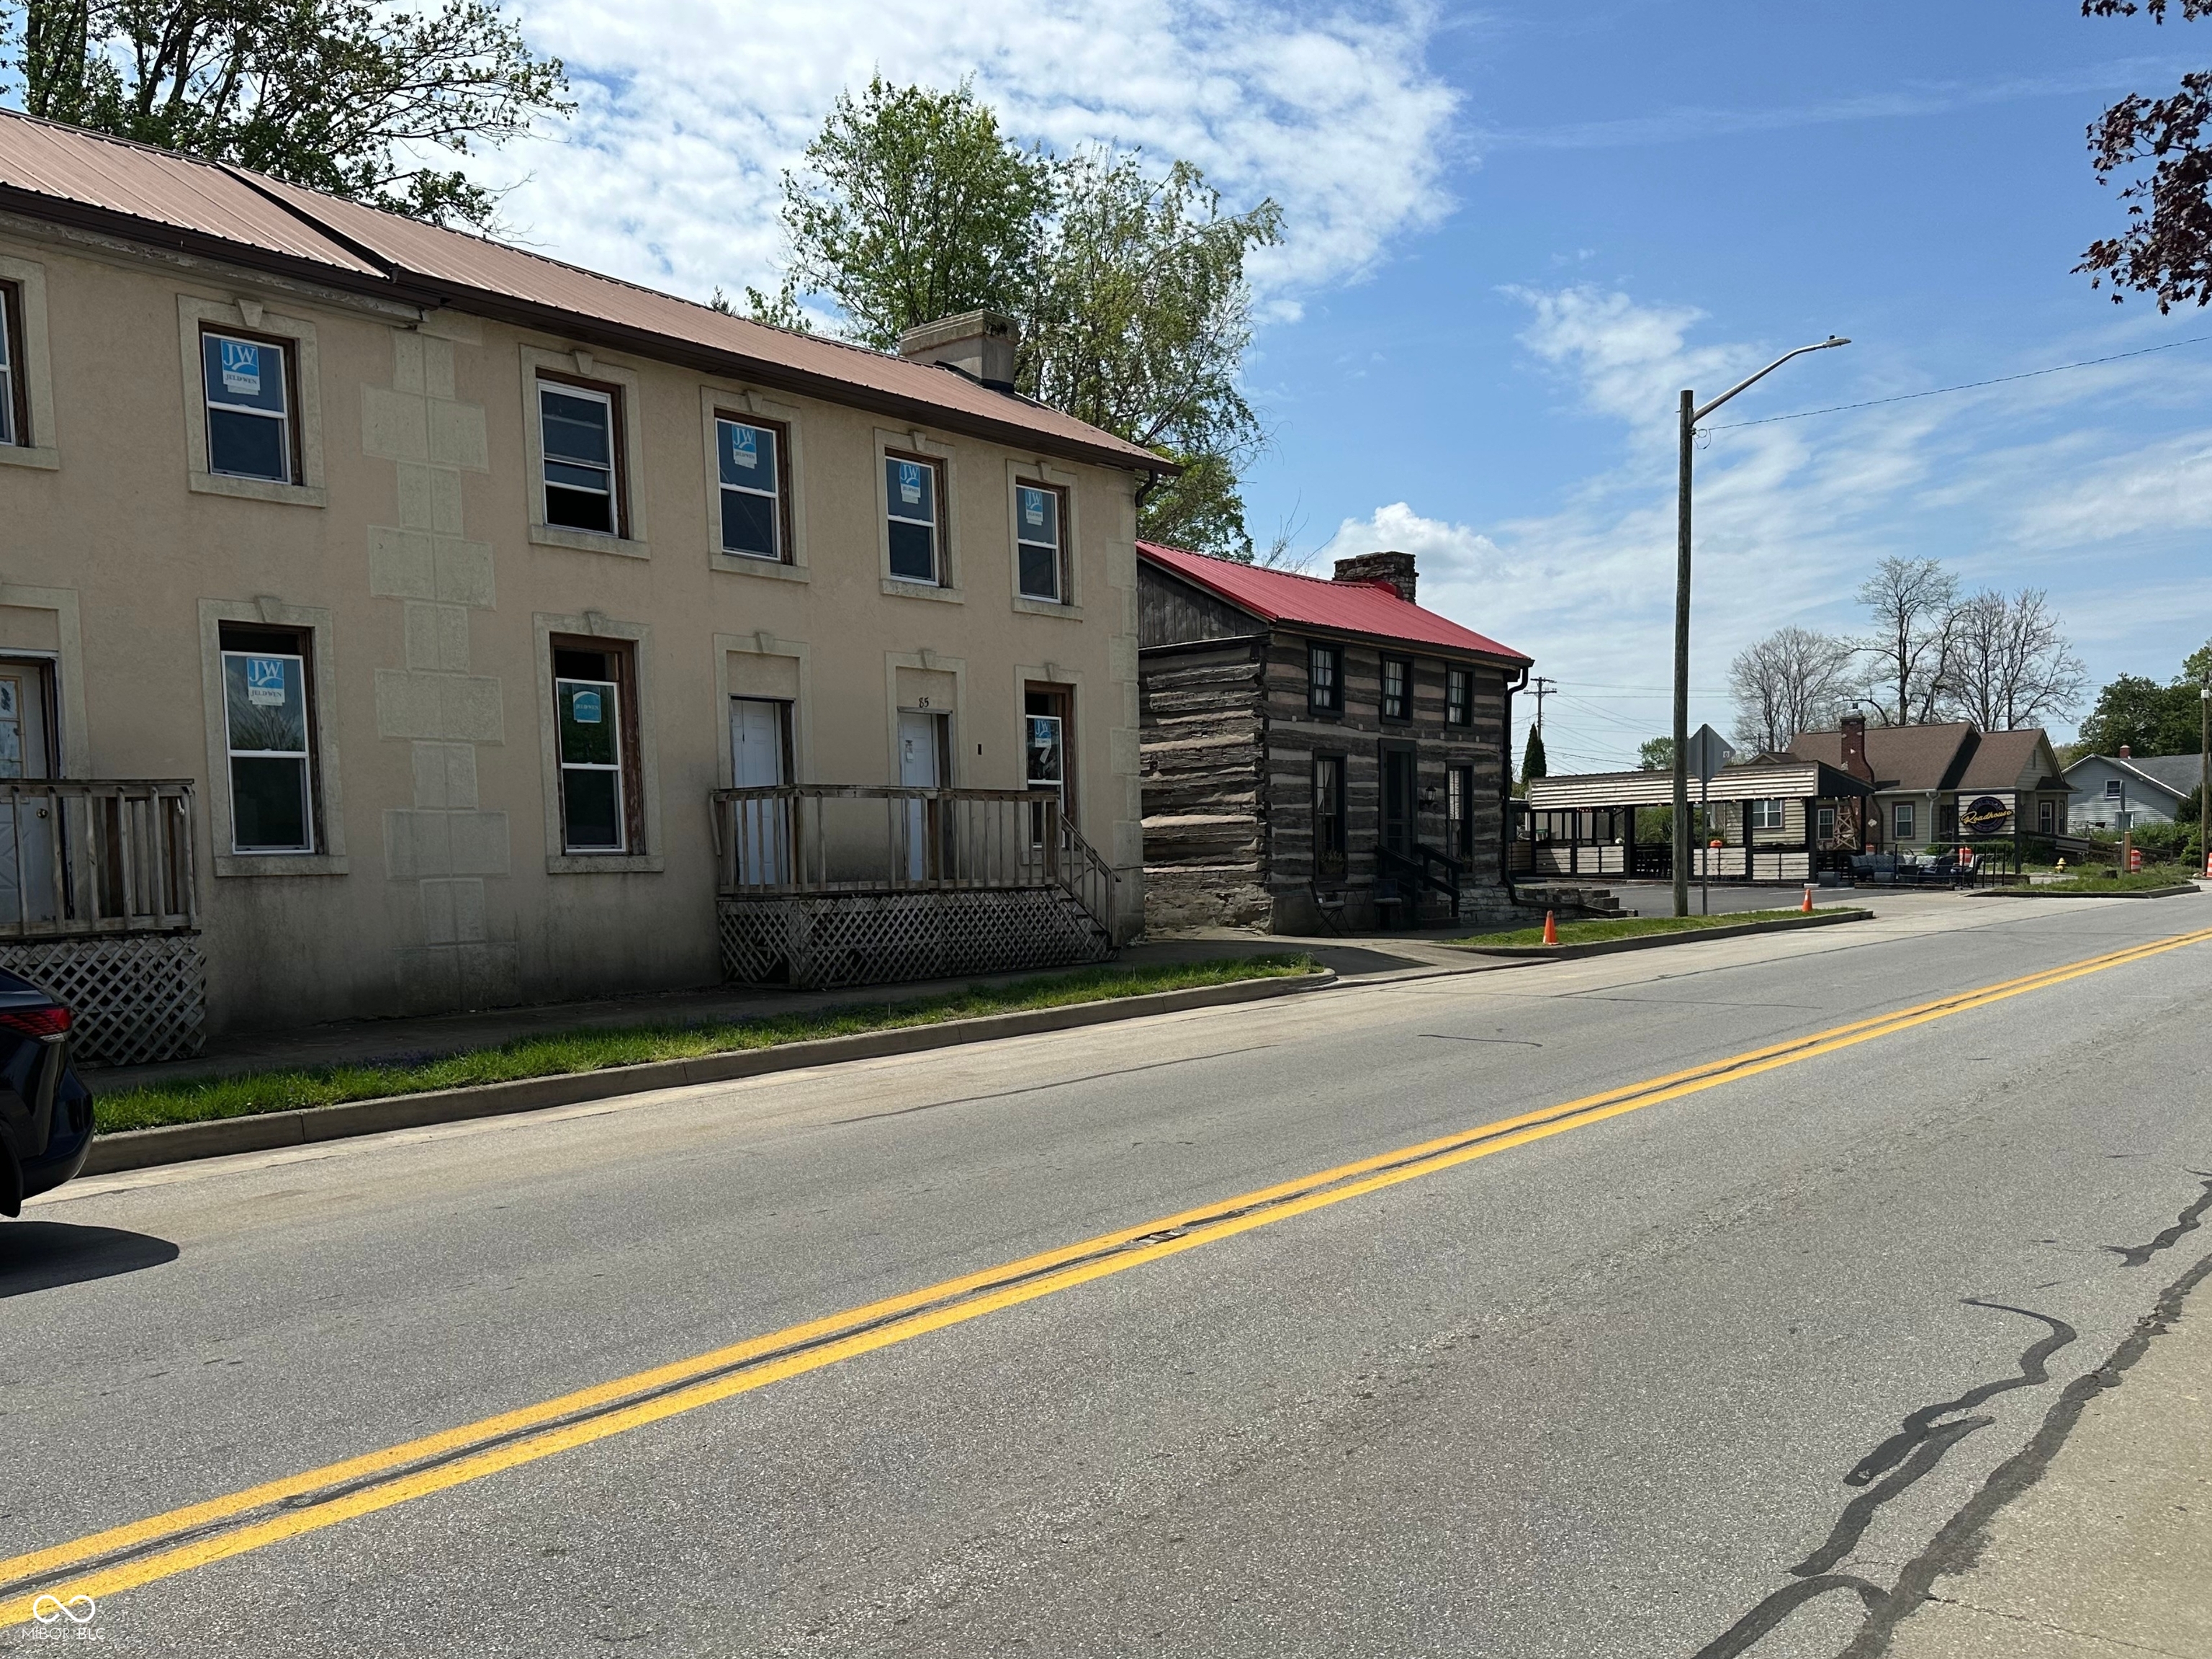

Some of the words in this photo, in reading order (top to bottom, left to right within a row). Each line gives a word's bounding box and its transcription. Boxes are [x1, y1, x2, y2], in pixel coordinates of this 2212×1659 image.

[223, 343, 256, 366] JW
[733, 426, 755, 446] JW
[900, 464, 919, 481] JW
[1026, 490, 1042, 507] JW
[249, 660, 282, 682] JW
[919, 696, 930, 709] 85
[1961, 810, 2013, 824] Roadhouse
